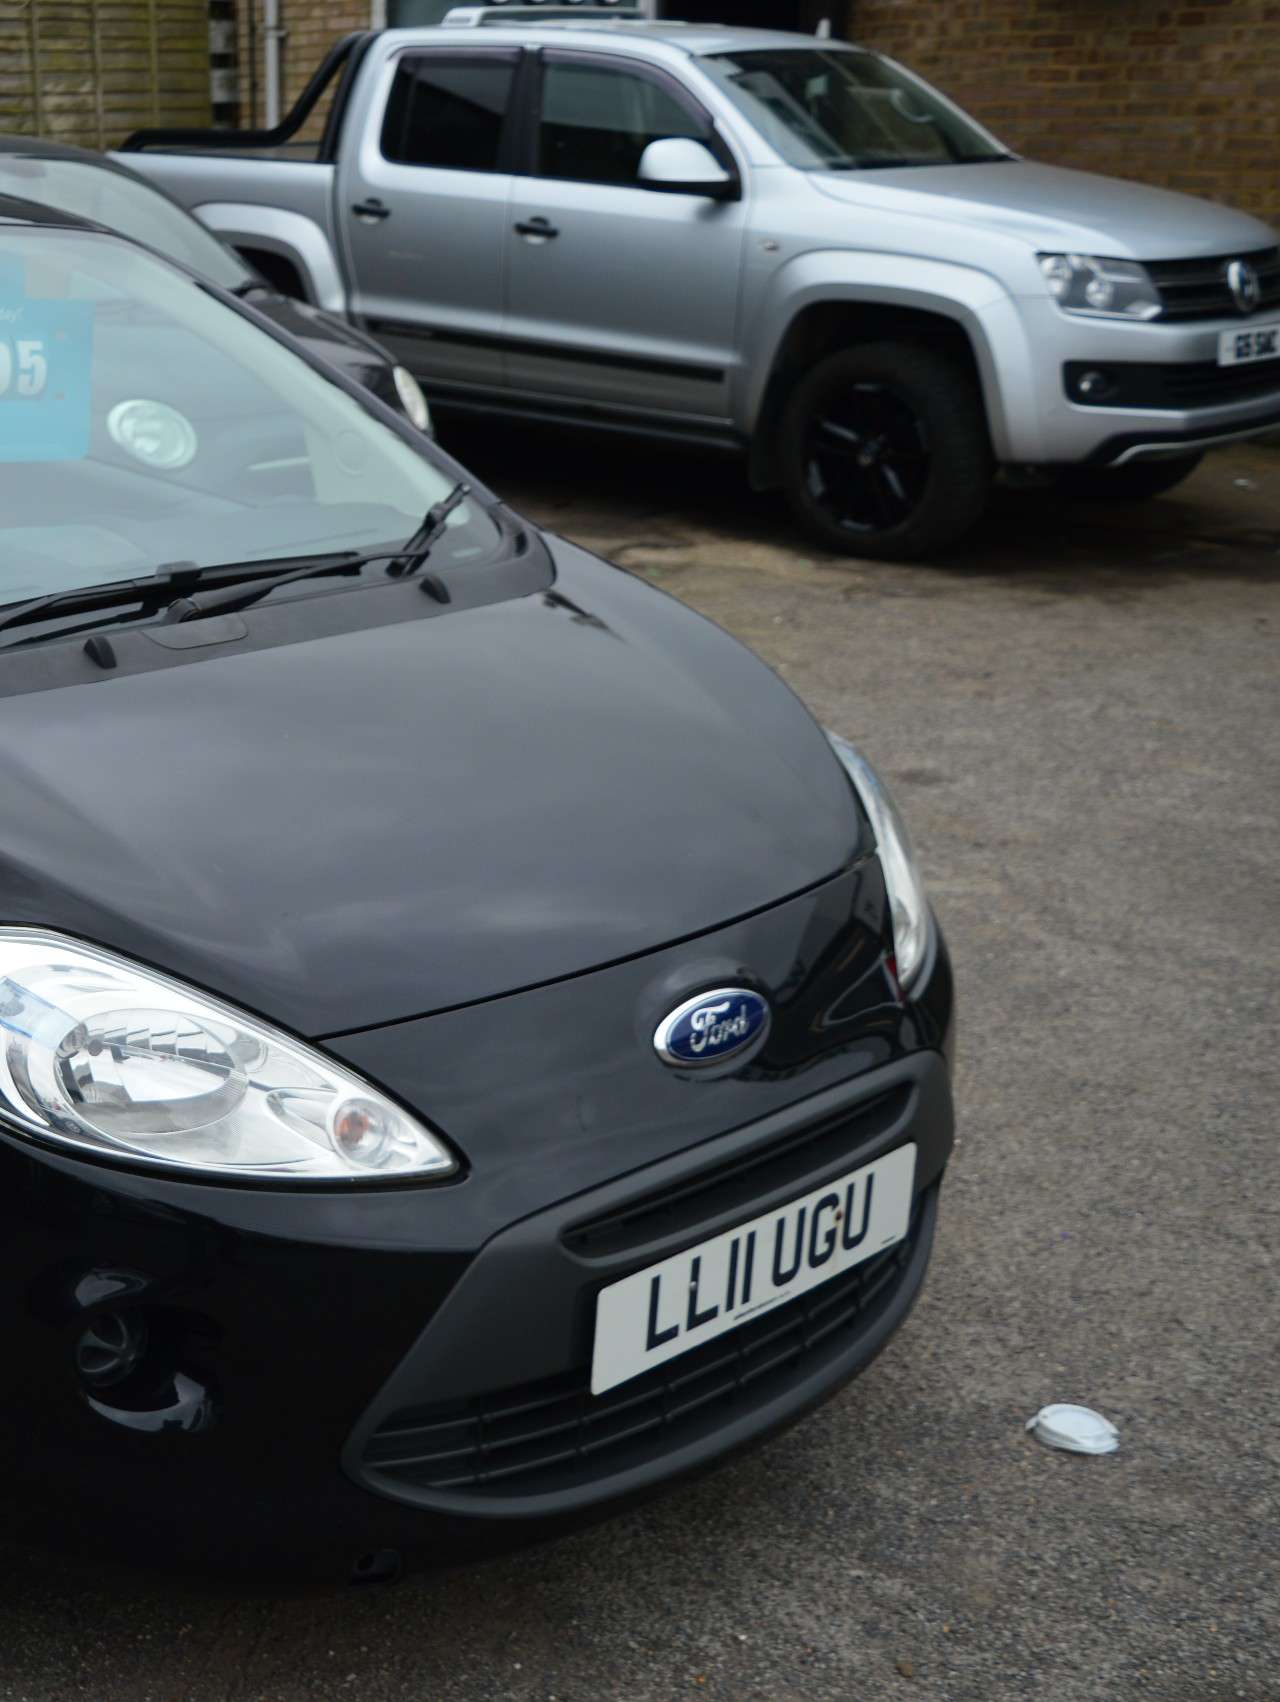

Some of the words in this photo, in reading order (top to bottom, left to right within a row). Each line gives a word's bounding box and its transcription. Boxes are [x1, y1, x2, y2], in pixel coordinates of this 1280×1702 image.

[689, 1001, 750, 1052] Ford
[645, 1230, 757, 1352] LL11
[771, 1172, 875, 1288] UGU
